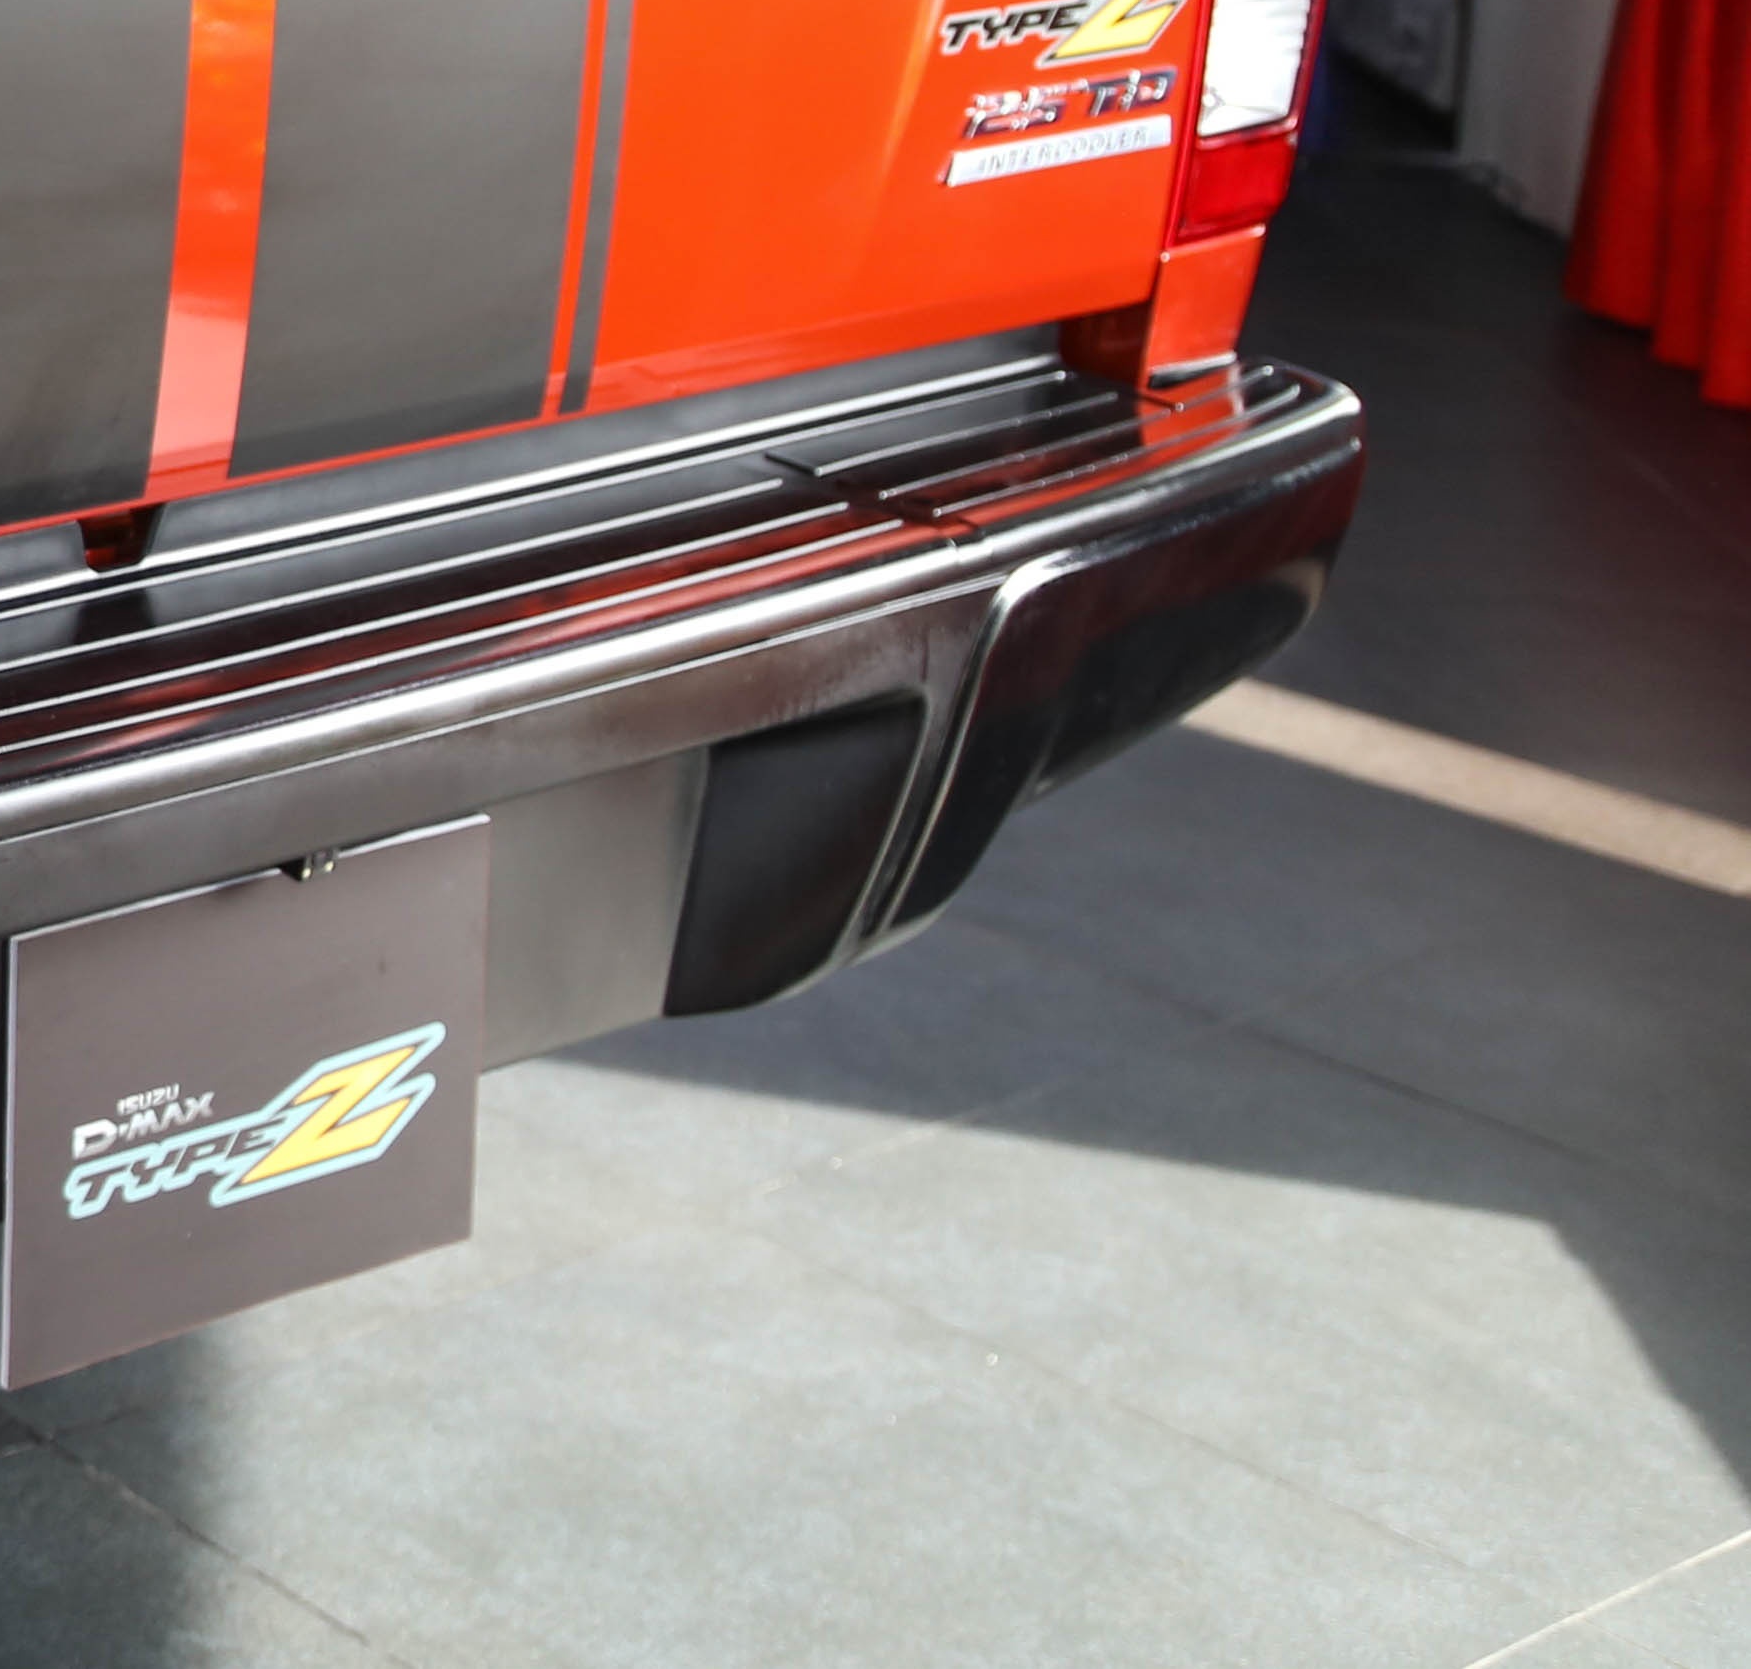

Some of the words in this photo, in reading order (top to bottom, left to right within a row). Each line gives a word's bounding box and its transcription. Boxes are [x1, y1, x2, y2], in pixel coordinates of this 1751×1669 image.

[975, 126, 1149, 173] INTERCOOLER
[117, 1083, 180, 1116] ISUZU
[72, 1091, 215, 1160] D-MAX
